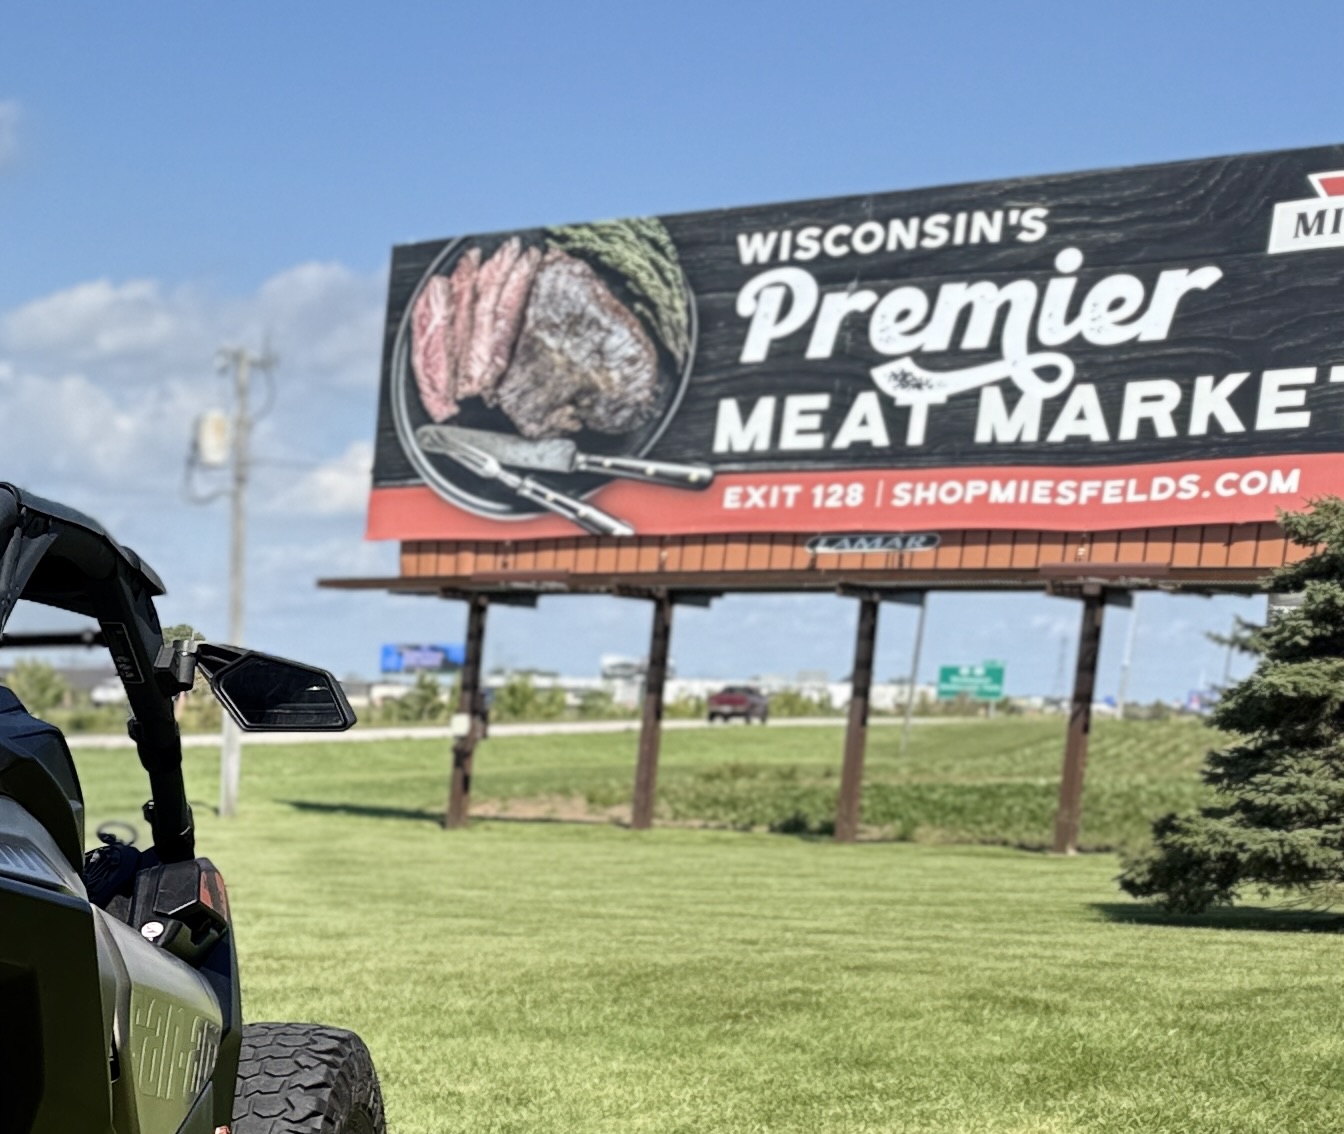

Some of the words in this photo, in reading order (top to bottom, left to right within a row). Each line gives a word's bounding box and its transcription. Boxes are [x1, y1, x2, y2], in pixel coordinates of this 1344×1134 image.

[736, 207, 1050, 266] WISCONSIN'S
[736, 247, 1224, 399] Premier
[713, 390, 948, 453] MEAT
[974, 365, 1344, 443] MARKE
[722, 484, 801, 509] EXIT
[811, 482, 865, 508] 128
[891, 467, 1301, 509] SHOPMIESFELDS.COM
[815, 535, 928, 551] LAMAR
